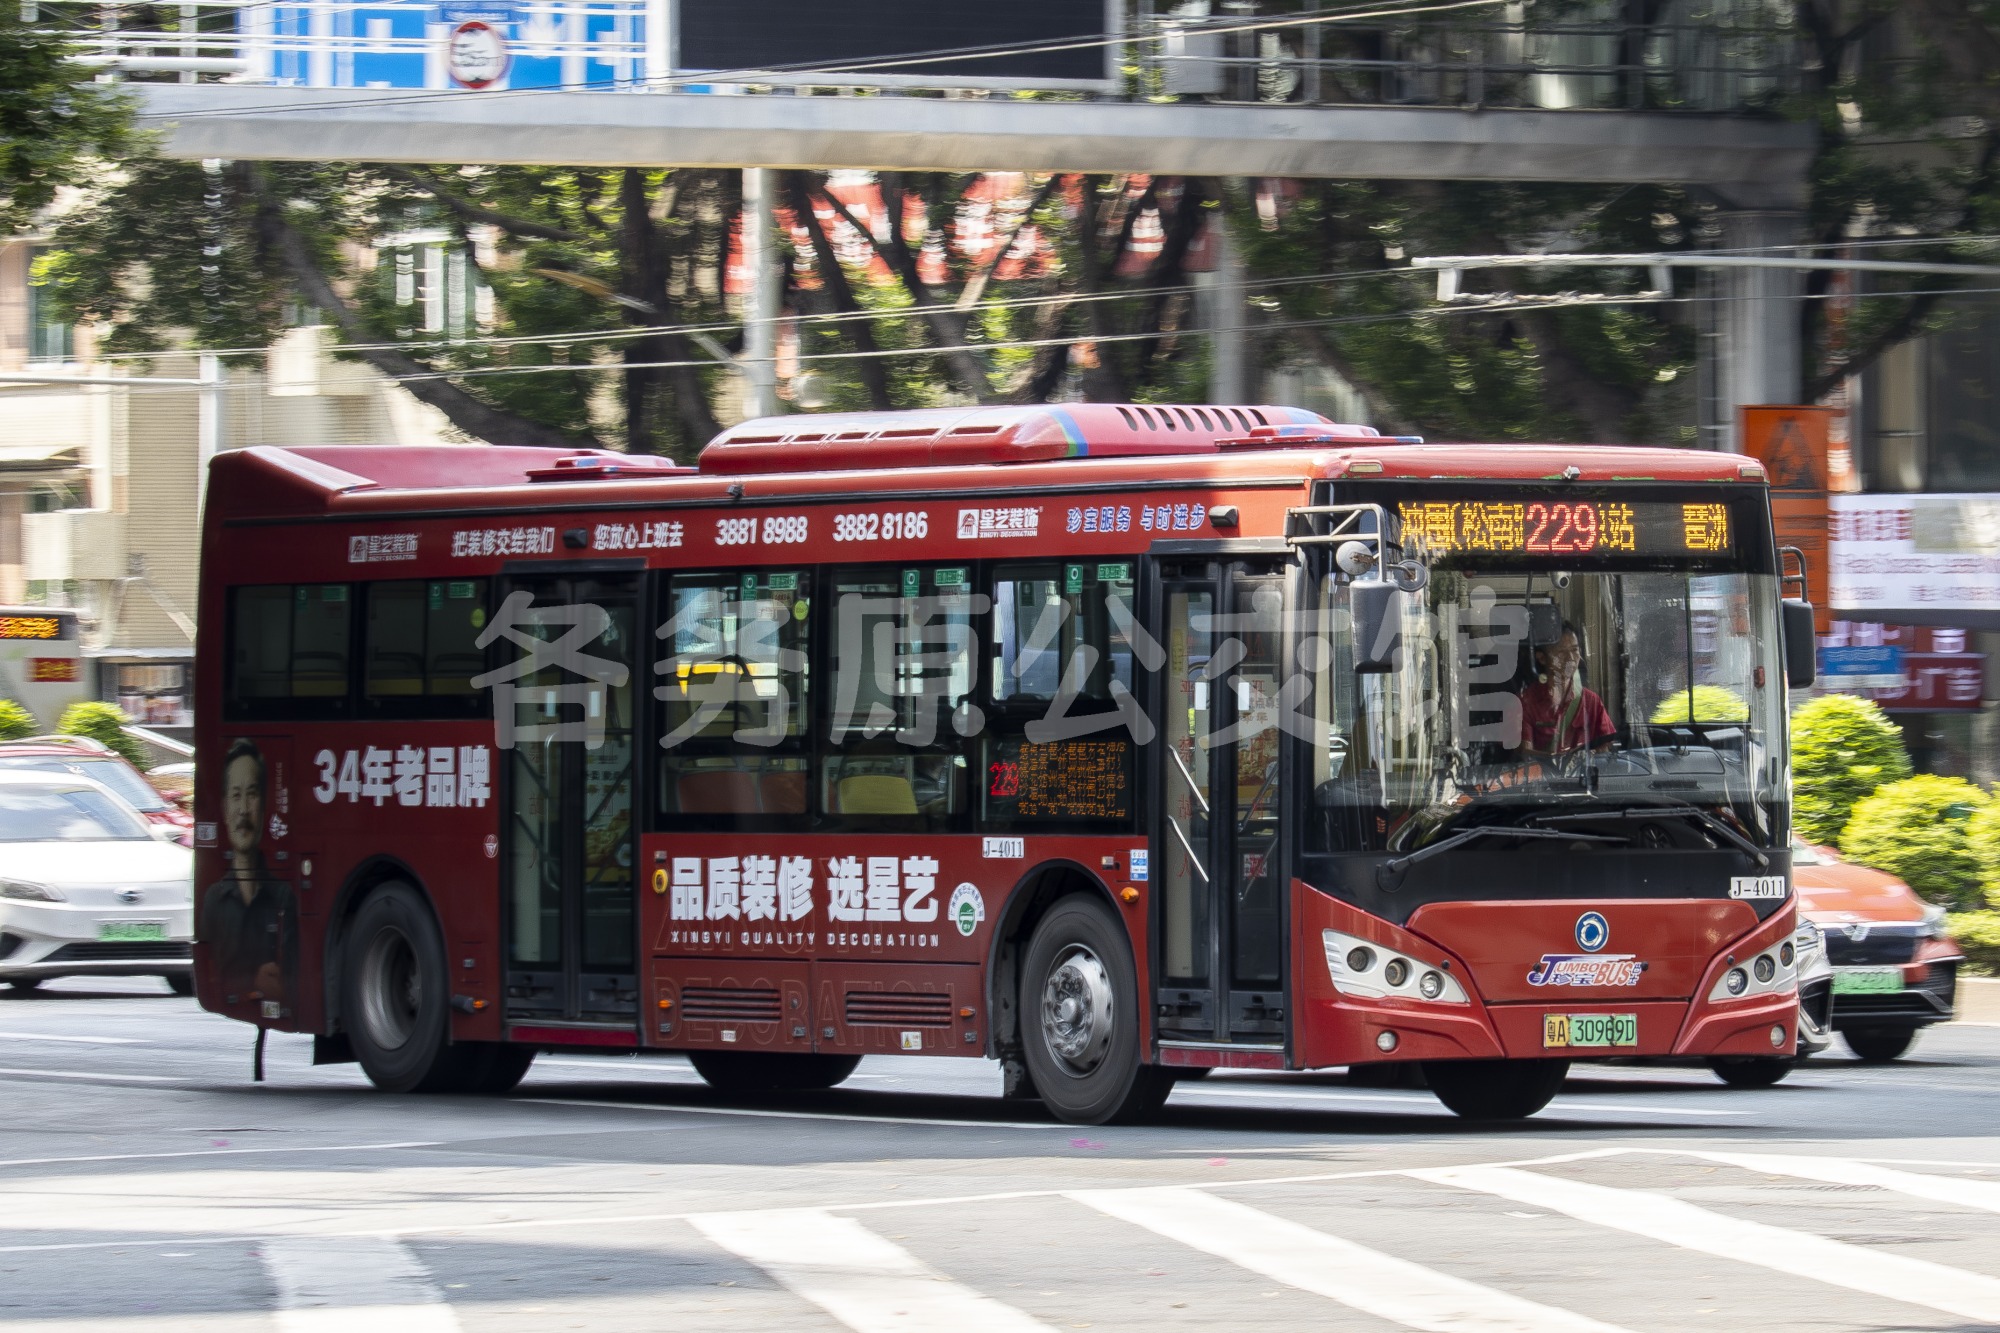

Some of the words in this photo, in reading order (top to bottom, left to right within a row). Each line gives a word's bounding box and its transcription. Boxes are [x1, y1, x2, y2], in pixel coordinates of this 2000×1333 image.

[715, 517, 757, 545] 3881
[762, 515, 808, 544] 8988
[832, 513, 879, 541] 3882
[880, 511, 926, 540] 8186
[980, 508, 1039, 529] 星艺装饰
[1065, 506, 1132, 533] 珍宝服务
[1139, 503, 1203, 530] 与时进步
[1526, 503, 1596, 551] 229
[451, 527, 556, 558] 把装修交给我们
[592, 521, 684, 550] 您放心上班去
[312, 744, 492, 808] 34年老品牌
[989, 761, 1020, 796] 229
[984, 839, 1024, 858] J-4011
[669, 855, 815, 922] 品质装修
[827, 855, 940, 923] 选星艺
[1733, 879, 1784, 897] J-4011
[669, 931, 731, 944] XINGYI
[740, 931, 816, 946] QUALITY
[826, 932, 939, 947] DECORATION
